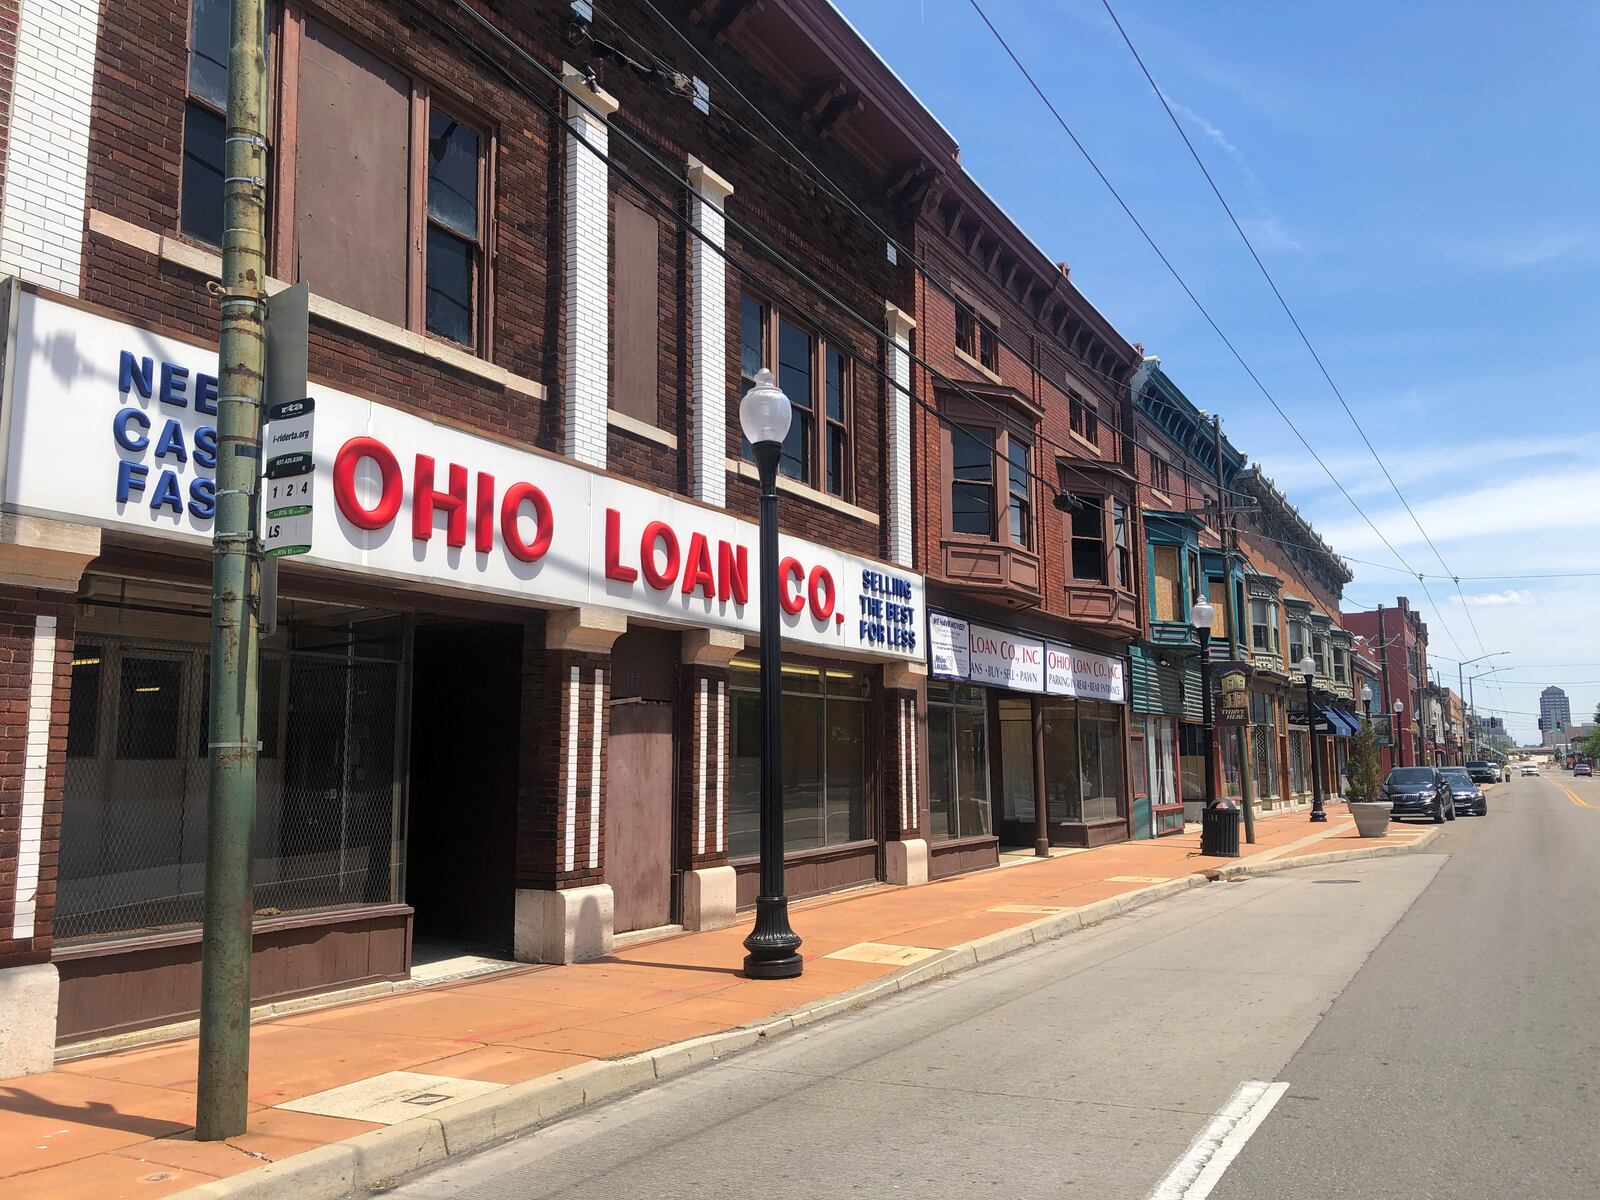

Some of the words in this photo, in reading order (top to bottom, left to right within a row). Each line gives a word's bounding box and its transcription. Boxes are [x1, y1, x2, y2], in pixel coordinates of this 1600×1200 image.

[118, 350, 218, 416] NEE
[113, 407, 217, 468] CAS
[116, 460, 215, 519] FAS
[273, 486, 277, 498] 1
[286, 484, 293, 496] 2
[301, 481, 308, 494] 4
[268, 525, 280, 538] LS
[333, 436, 554, 563] OHIO
[605, 507, 748, 605] LOAN
[778, 556, 845, 624] CO.
[862, 568, 912, 600] SELLING
[859, 594, 883, 619] THE
[886, 601, 915, 625] BEST
[859, 620, 885, 643] FOR
[887, 625, 916, 649] LESS
[971, 634, 997, 655] LOAN
[1022, 647, 1041, 664] INC.
[971, 662, 983, 675] ANS
[987, 665, 1000, 678] BUY
[1004, 668, 1015, 680] SELL
[1020, 671, 1038, 683] PAWN
[1048, 652, 1070, 671] OHIO
[1073, 657, 1092, 674] LOAN
[1048, 673, 1070, 688] PARKING
